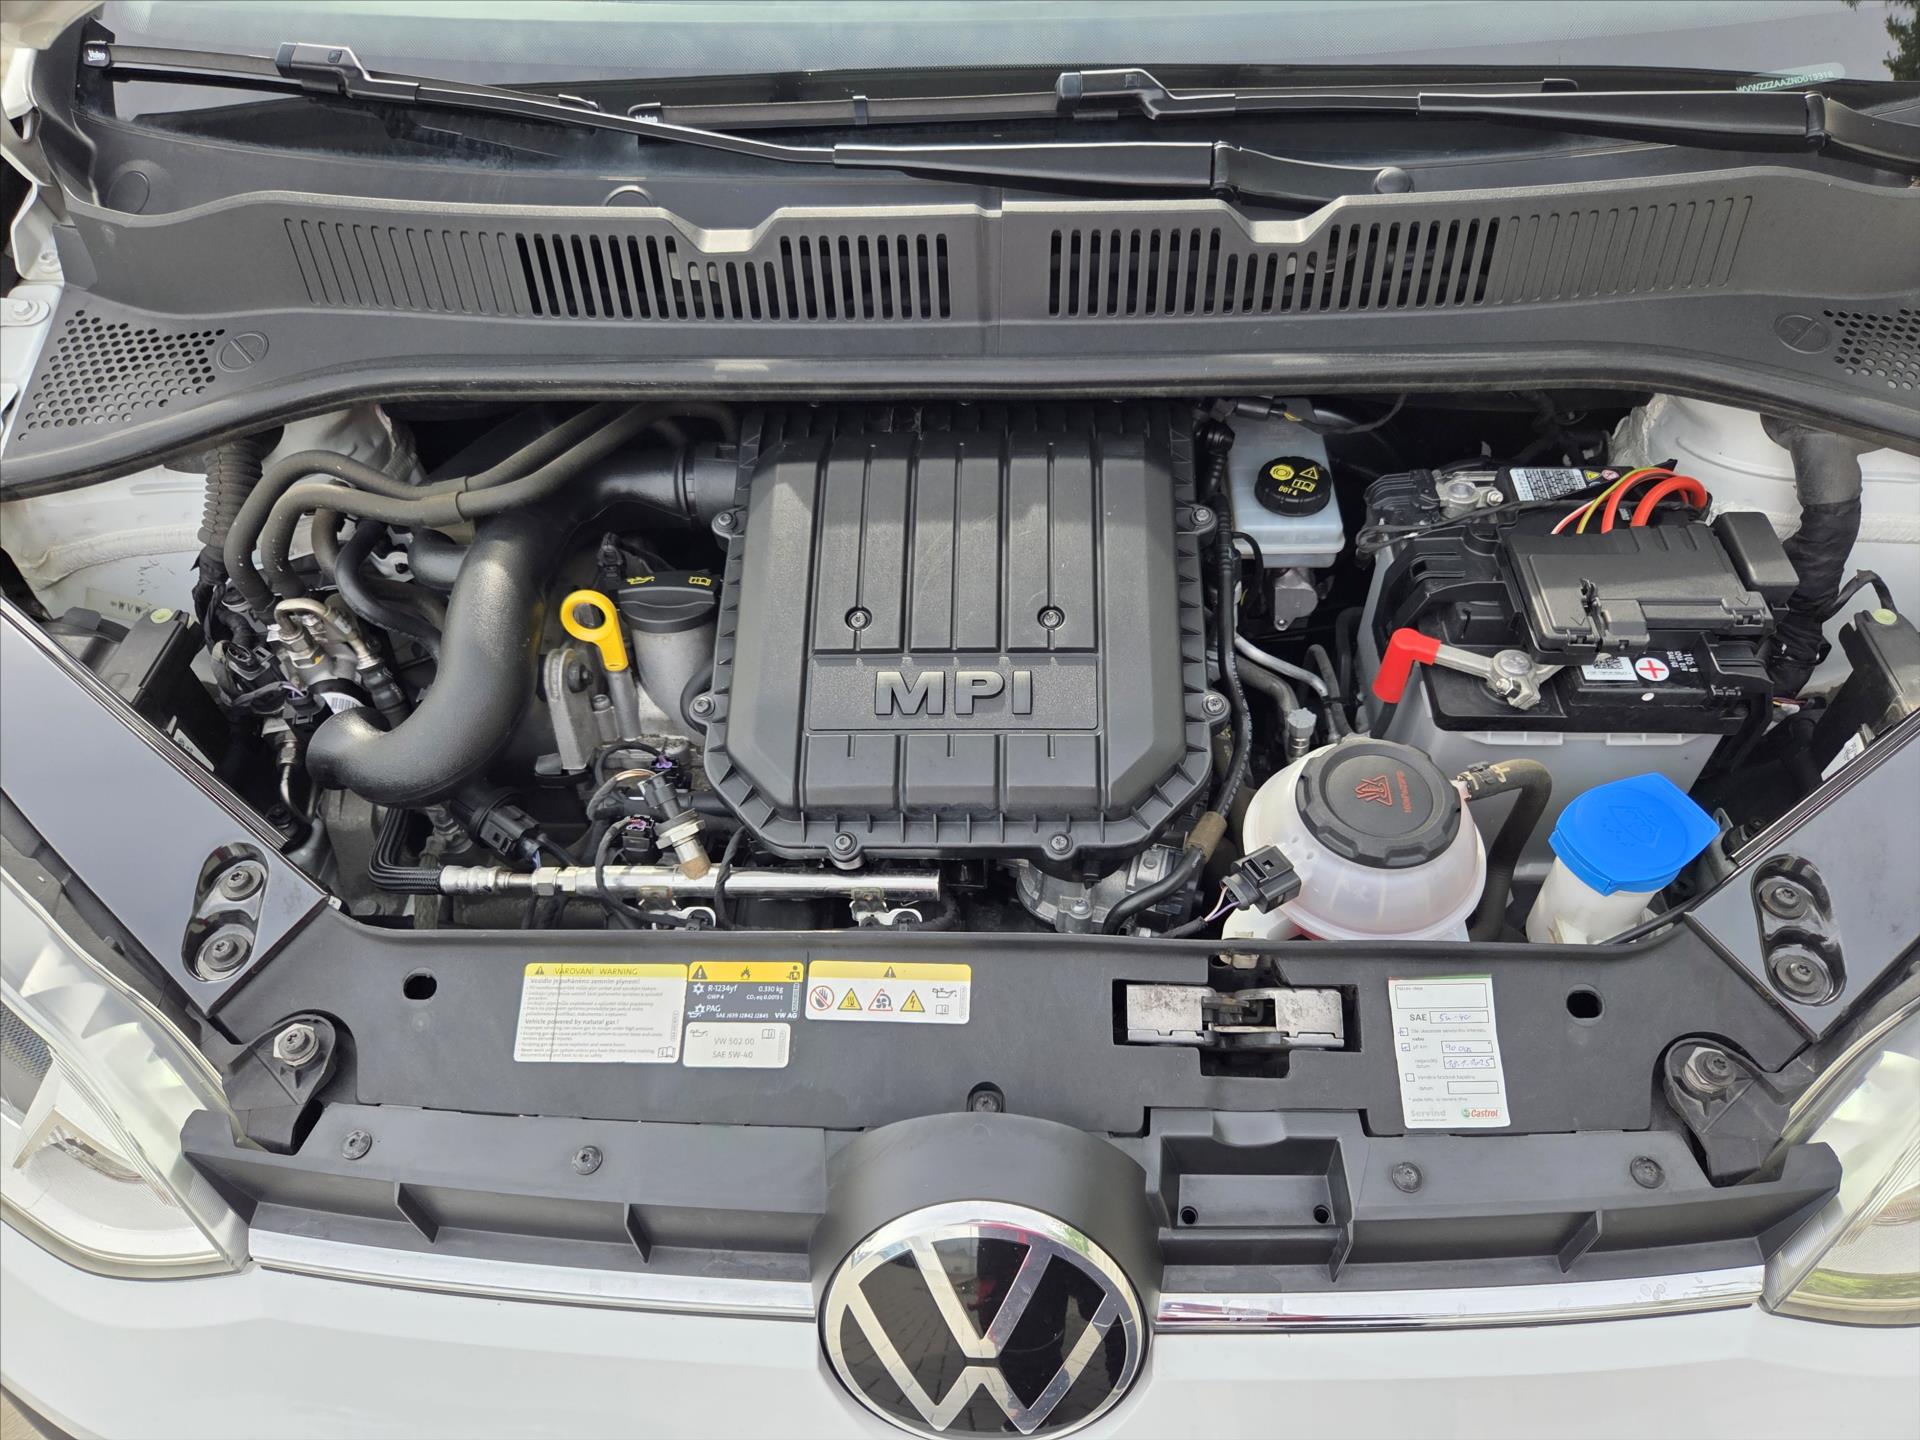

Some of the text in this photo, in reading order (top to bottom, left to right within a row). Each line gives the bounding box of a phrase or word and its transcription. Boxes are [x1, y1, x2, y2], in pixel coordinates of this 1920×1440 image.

[874, 669, 1033, 716] MPI
[600, 967, 638, 975] WARNING
[707, 984, 738, 994] R-1234yf
[776, 986, 784, 994] kg
[706, 1004, 721, 1012] PAG
[1409, 1013, 1428, 1021] SAE
[712, 1050, 726, 1058] SAE
[1471, 1109, 1498, 1118] Castrol
